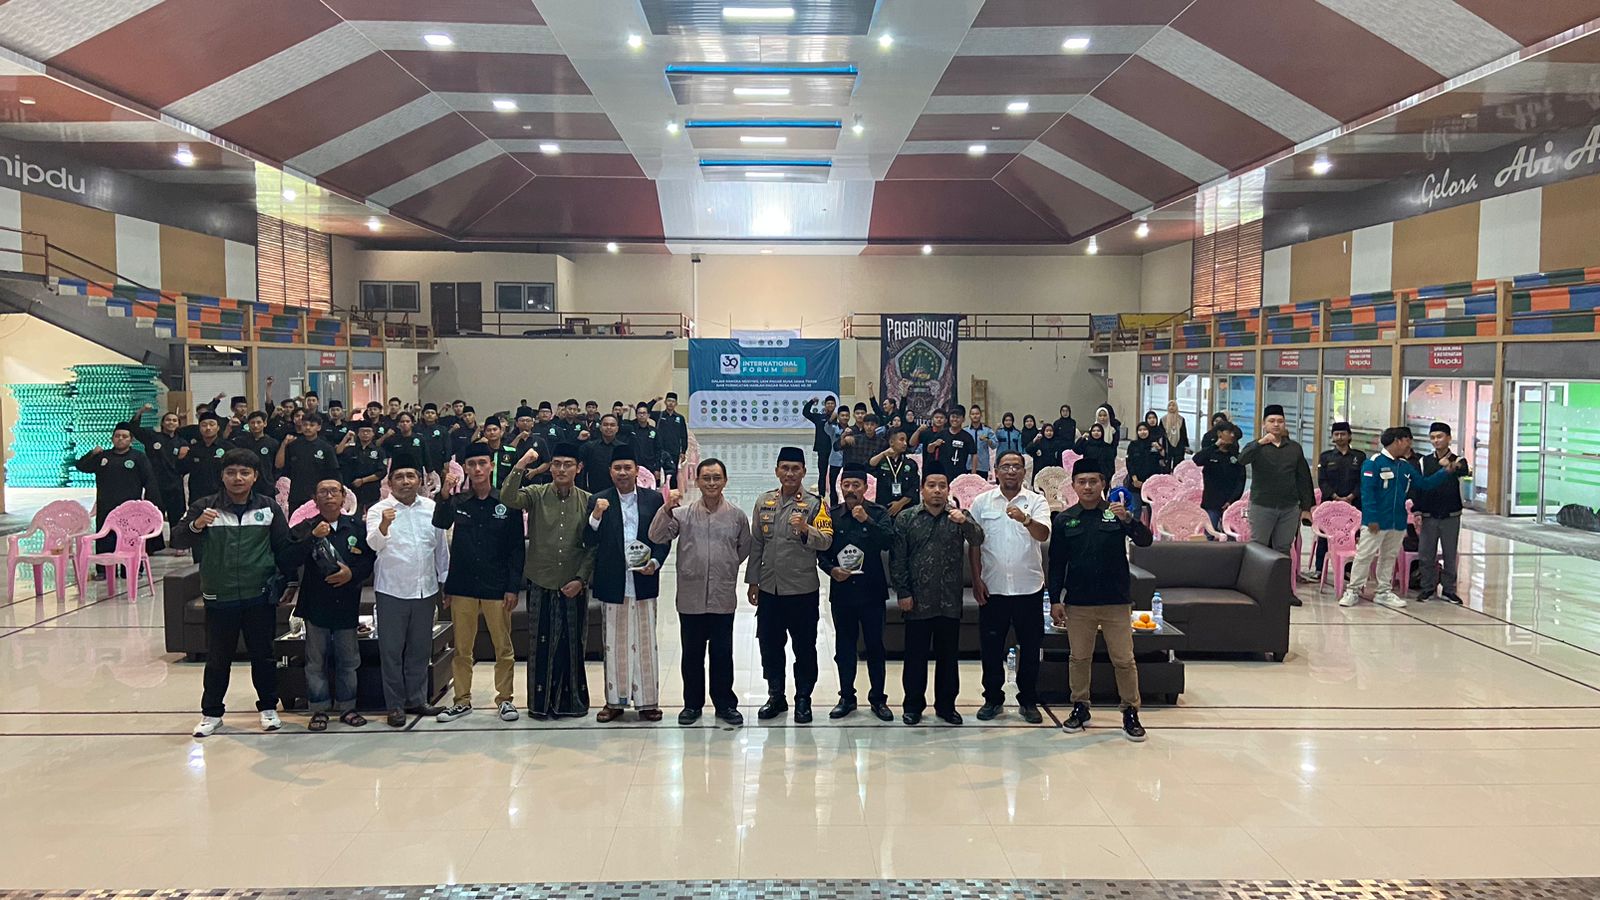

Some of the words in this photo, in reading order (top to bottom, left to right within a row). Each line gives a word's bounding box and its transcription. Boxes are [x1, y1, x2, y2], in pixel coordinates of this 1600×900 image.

[1421, 168, 1478, 208] Gelora
[1494, 140, 1554, 187] Abi
[887, 318, 954, 343] PAGARNUSA
[722, 356, 739, 368] 39
